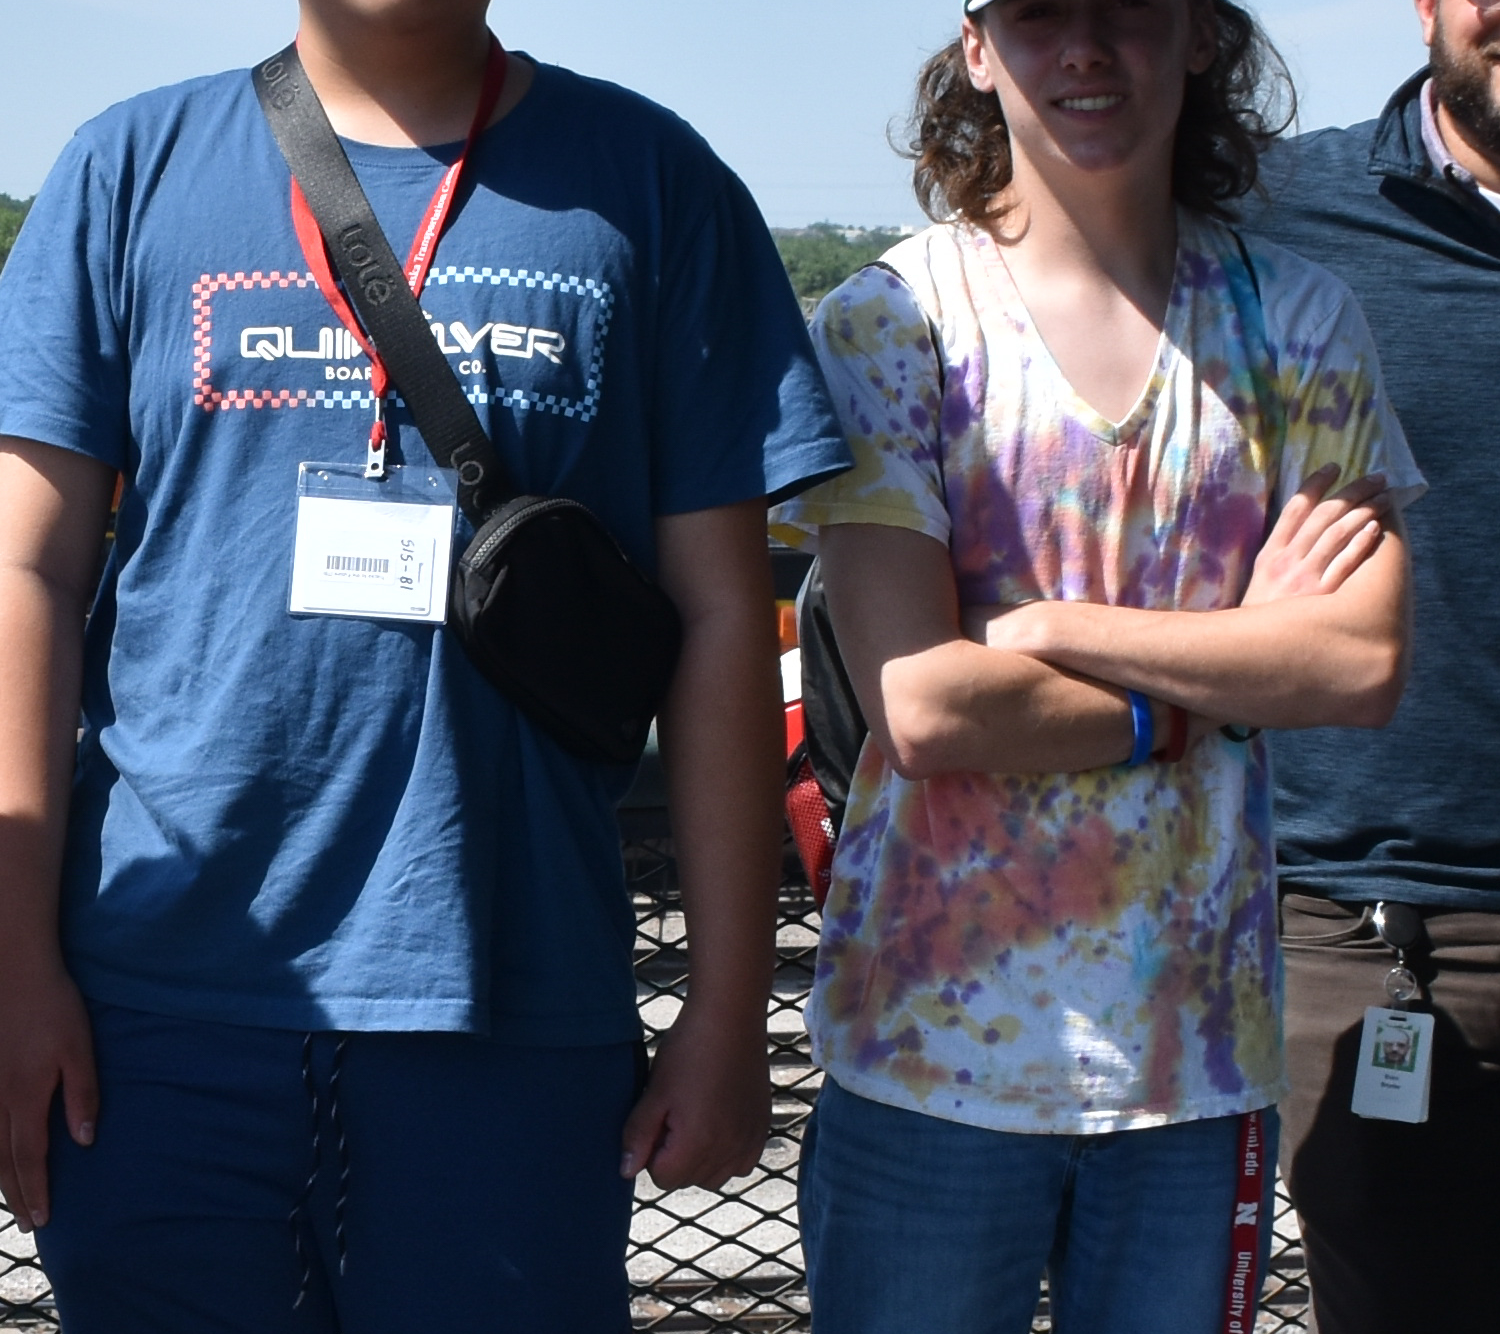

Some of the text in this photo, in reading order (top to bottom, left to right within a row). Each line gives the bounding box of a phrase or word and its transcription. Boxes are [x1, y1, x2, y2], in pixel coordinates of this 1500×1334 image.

[413, 193, 448, 263] Transportation
[458, 360, 487, 375] CO.
[1244, 1112, 1260, 1176] w.unl.edu
[1228, 1251, 1252, 1318] University
[1228, 1321, 1244, 1334] of
